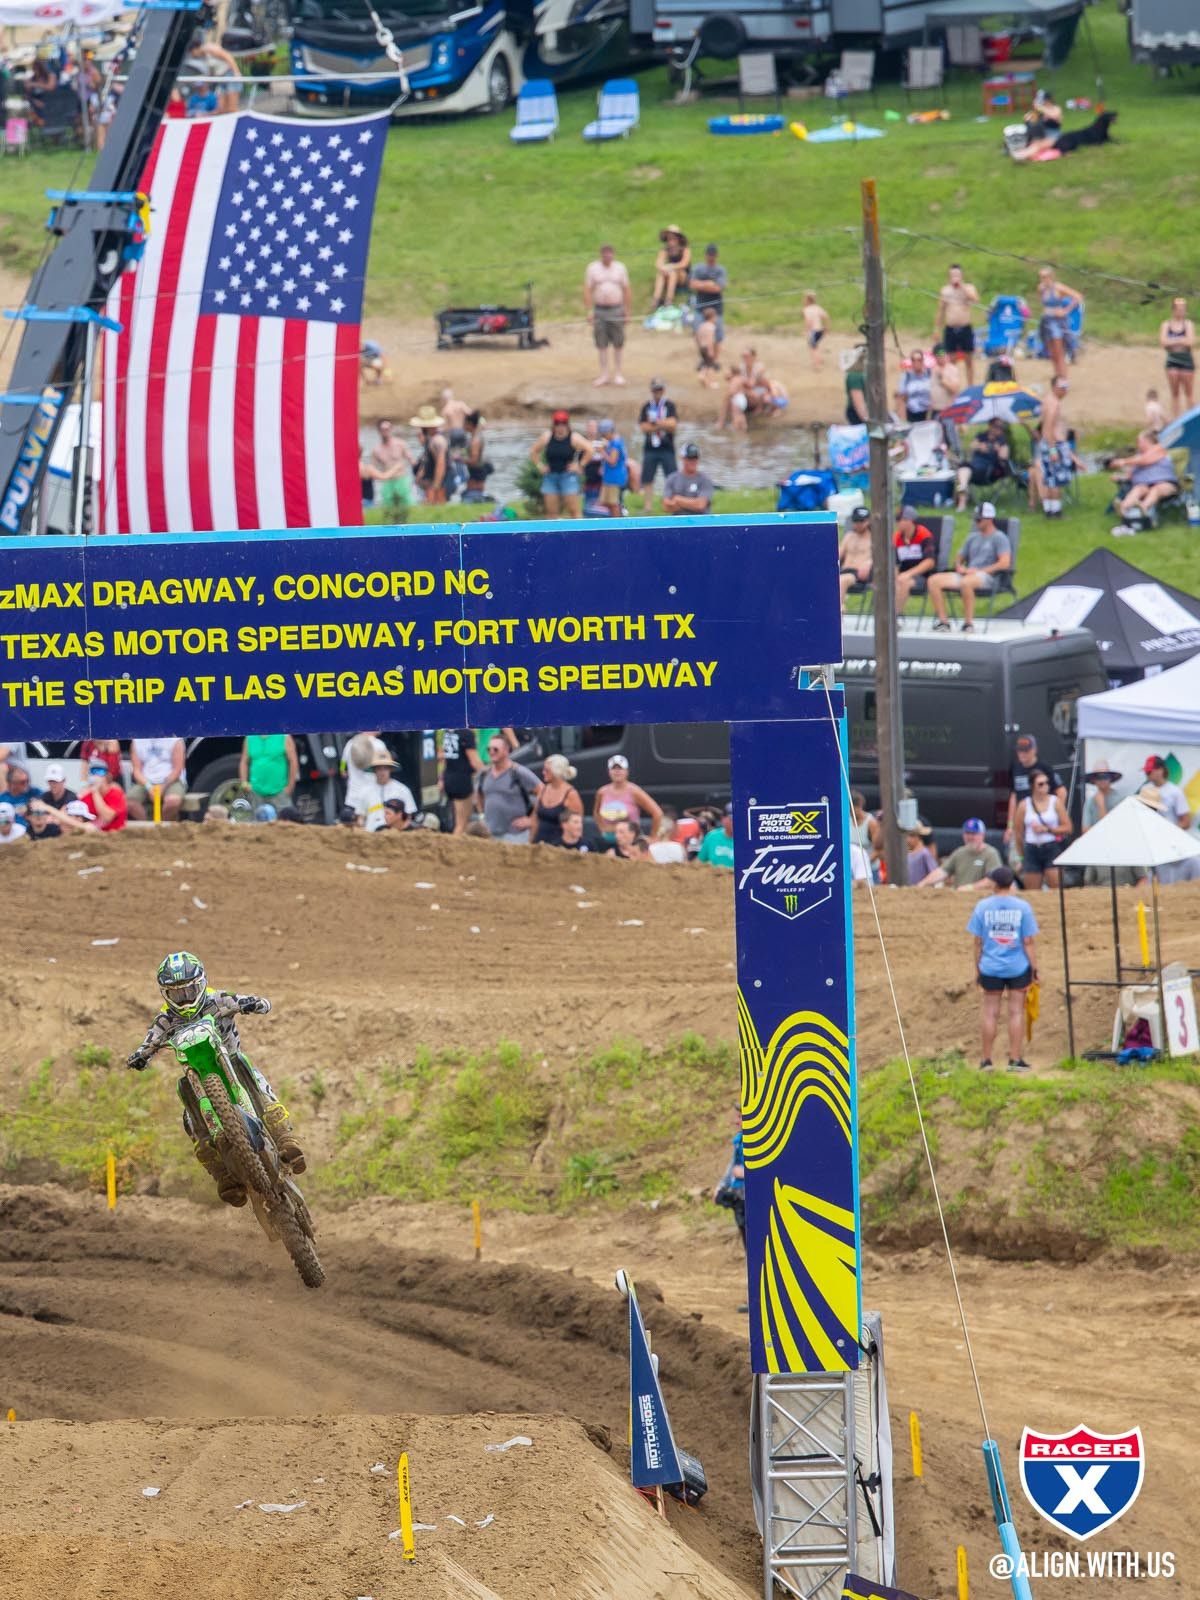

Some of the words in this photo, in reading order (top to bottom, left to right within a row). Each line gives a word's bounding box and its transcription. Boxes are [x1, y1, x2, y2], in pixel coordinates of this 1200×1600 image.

[0, 583, 85, 609] zMAX
[93, 576, 265, 606] DRAGWAY,
[274, 570, 435, 601] CONCORD
[445, 569, 490, 595] NC
[0, 631, 104, 660] TEXAS
[114, 628, 228, 657] MOTOR
[237, 621, 425, 652] SPEEDWAY,
[434, 619, 520, 647] FORT
[527, 615, 645, 644] WORTH
[654, 613, 696, 640] TX
[2, 681, 65, 707] THE
[74, 678, 165, 706] STRIP
[174, 676, 215, 703] AT
[225, 673, 286, 701] LAS
[294, 670, 405, 698] VEGAS
[413, 667, 530, 695] MOTOR
[538, 661, 718, 691] SPEEDWAY
[739, 844, 837, 890] Finals
[642, 1394, 659, 1469] MOTOCROSS
